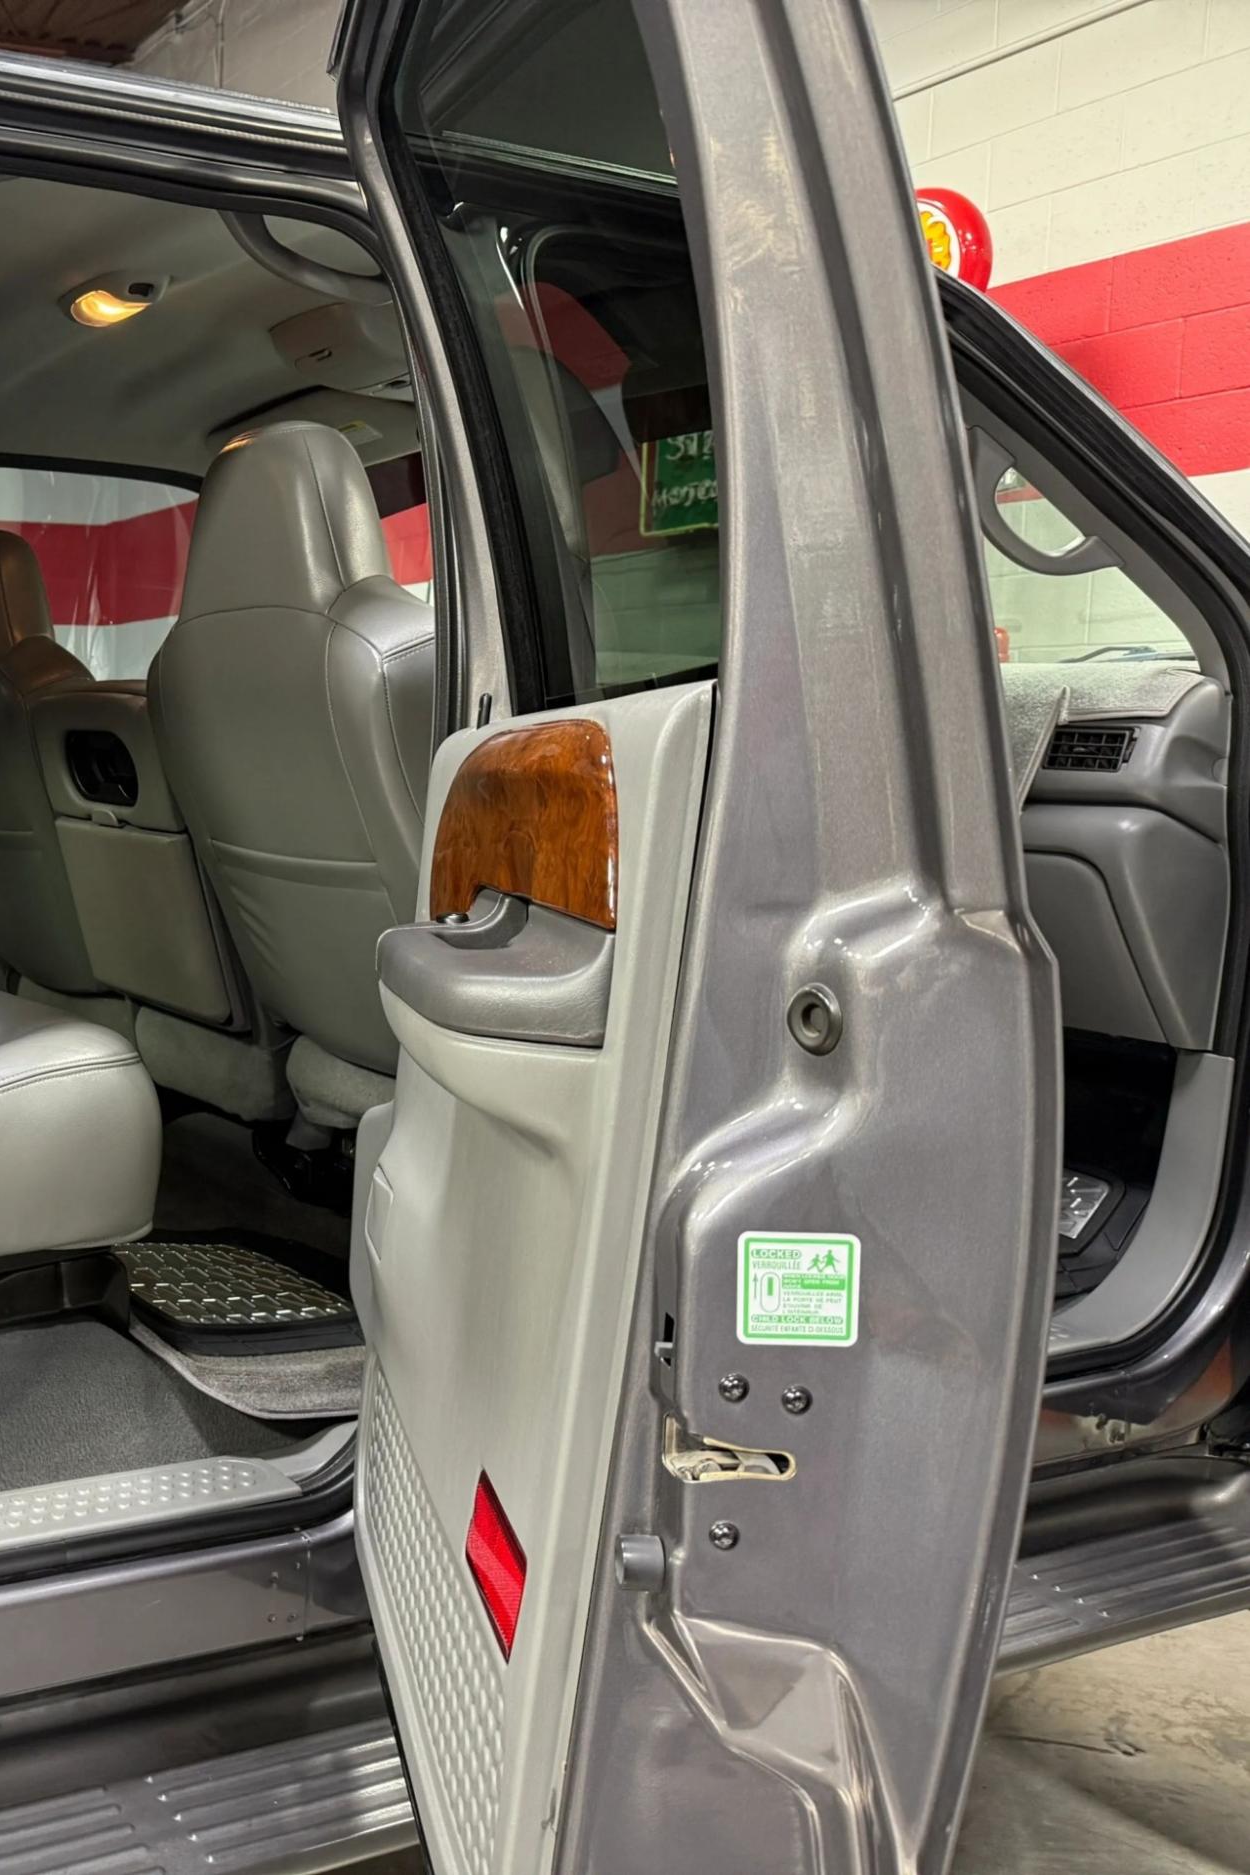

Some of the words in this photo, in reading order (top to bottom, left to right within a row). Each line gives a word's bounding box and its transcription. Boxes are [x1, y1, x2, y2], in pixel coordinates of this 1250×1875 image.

[753, 1249, 801, 1259] LOCKED
[752, 1315, 779, 1323] CHILD
[781, 1315, 806, 1324] LOCK
[809, 1316, 843, 1325] BELOW
